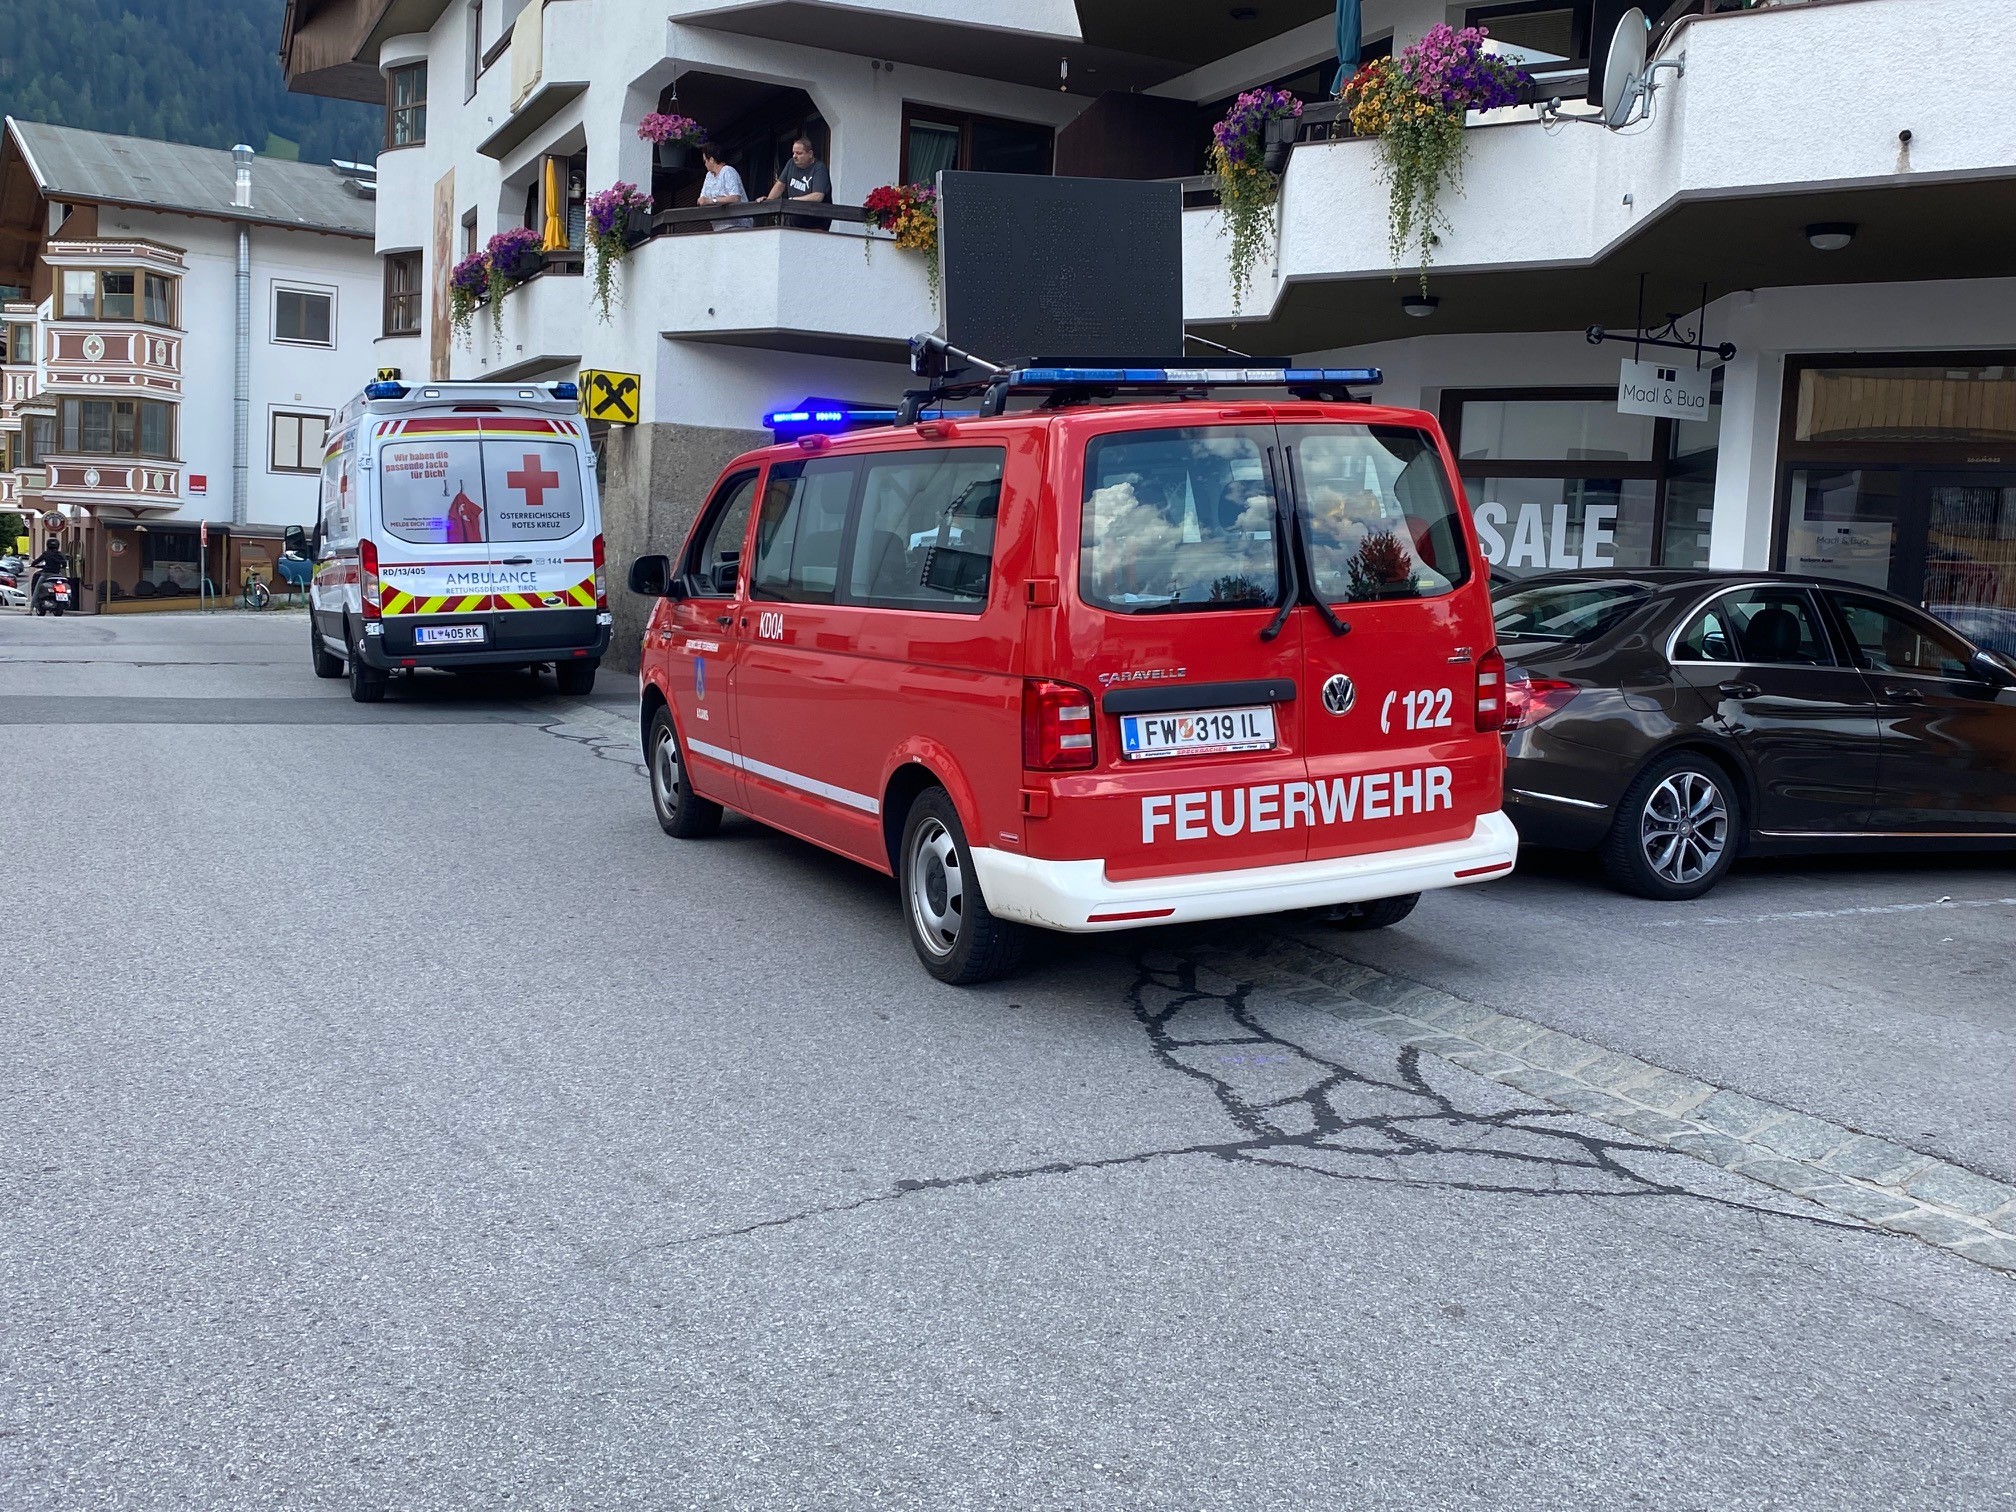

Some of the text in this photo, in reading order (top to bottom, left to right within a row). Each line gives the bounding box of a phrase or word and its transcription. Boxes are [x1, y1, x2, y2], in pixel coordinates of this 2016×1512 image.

[1623, 383, 1705, 408] Madl & Bua
[393, 451, 449, 462] Wir haben die
[385, 460, 449, 472] passende Jacke
[410, 470, 423, 479] für
[500, 511, 571, 519] ÖSTERREICHISCHES
[511, 521, 536, 529] ROTES
[1473, 501, 1618, 569] SALE
[382, 567, 426, 577] RD/13/405
[446, 571, 537, 585] AMBULANCE
[446, 585, 511, 594] RETTUNGSDIENST
[759, 611, 783, 640] KDOA
[427, 627, 479, 640] IL 405 RK
[1098, 667, 1186, 685] CARAVELLE
[1402, 687, 1453, 731] 122
[1145, 713, 1261, 746] FW 319 IL
[1141, 765, 1453, 844] FEUERWEHR
